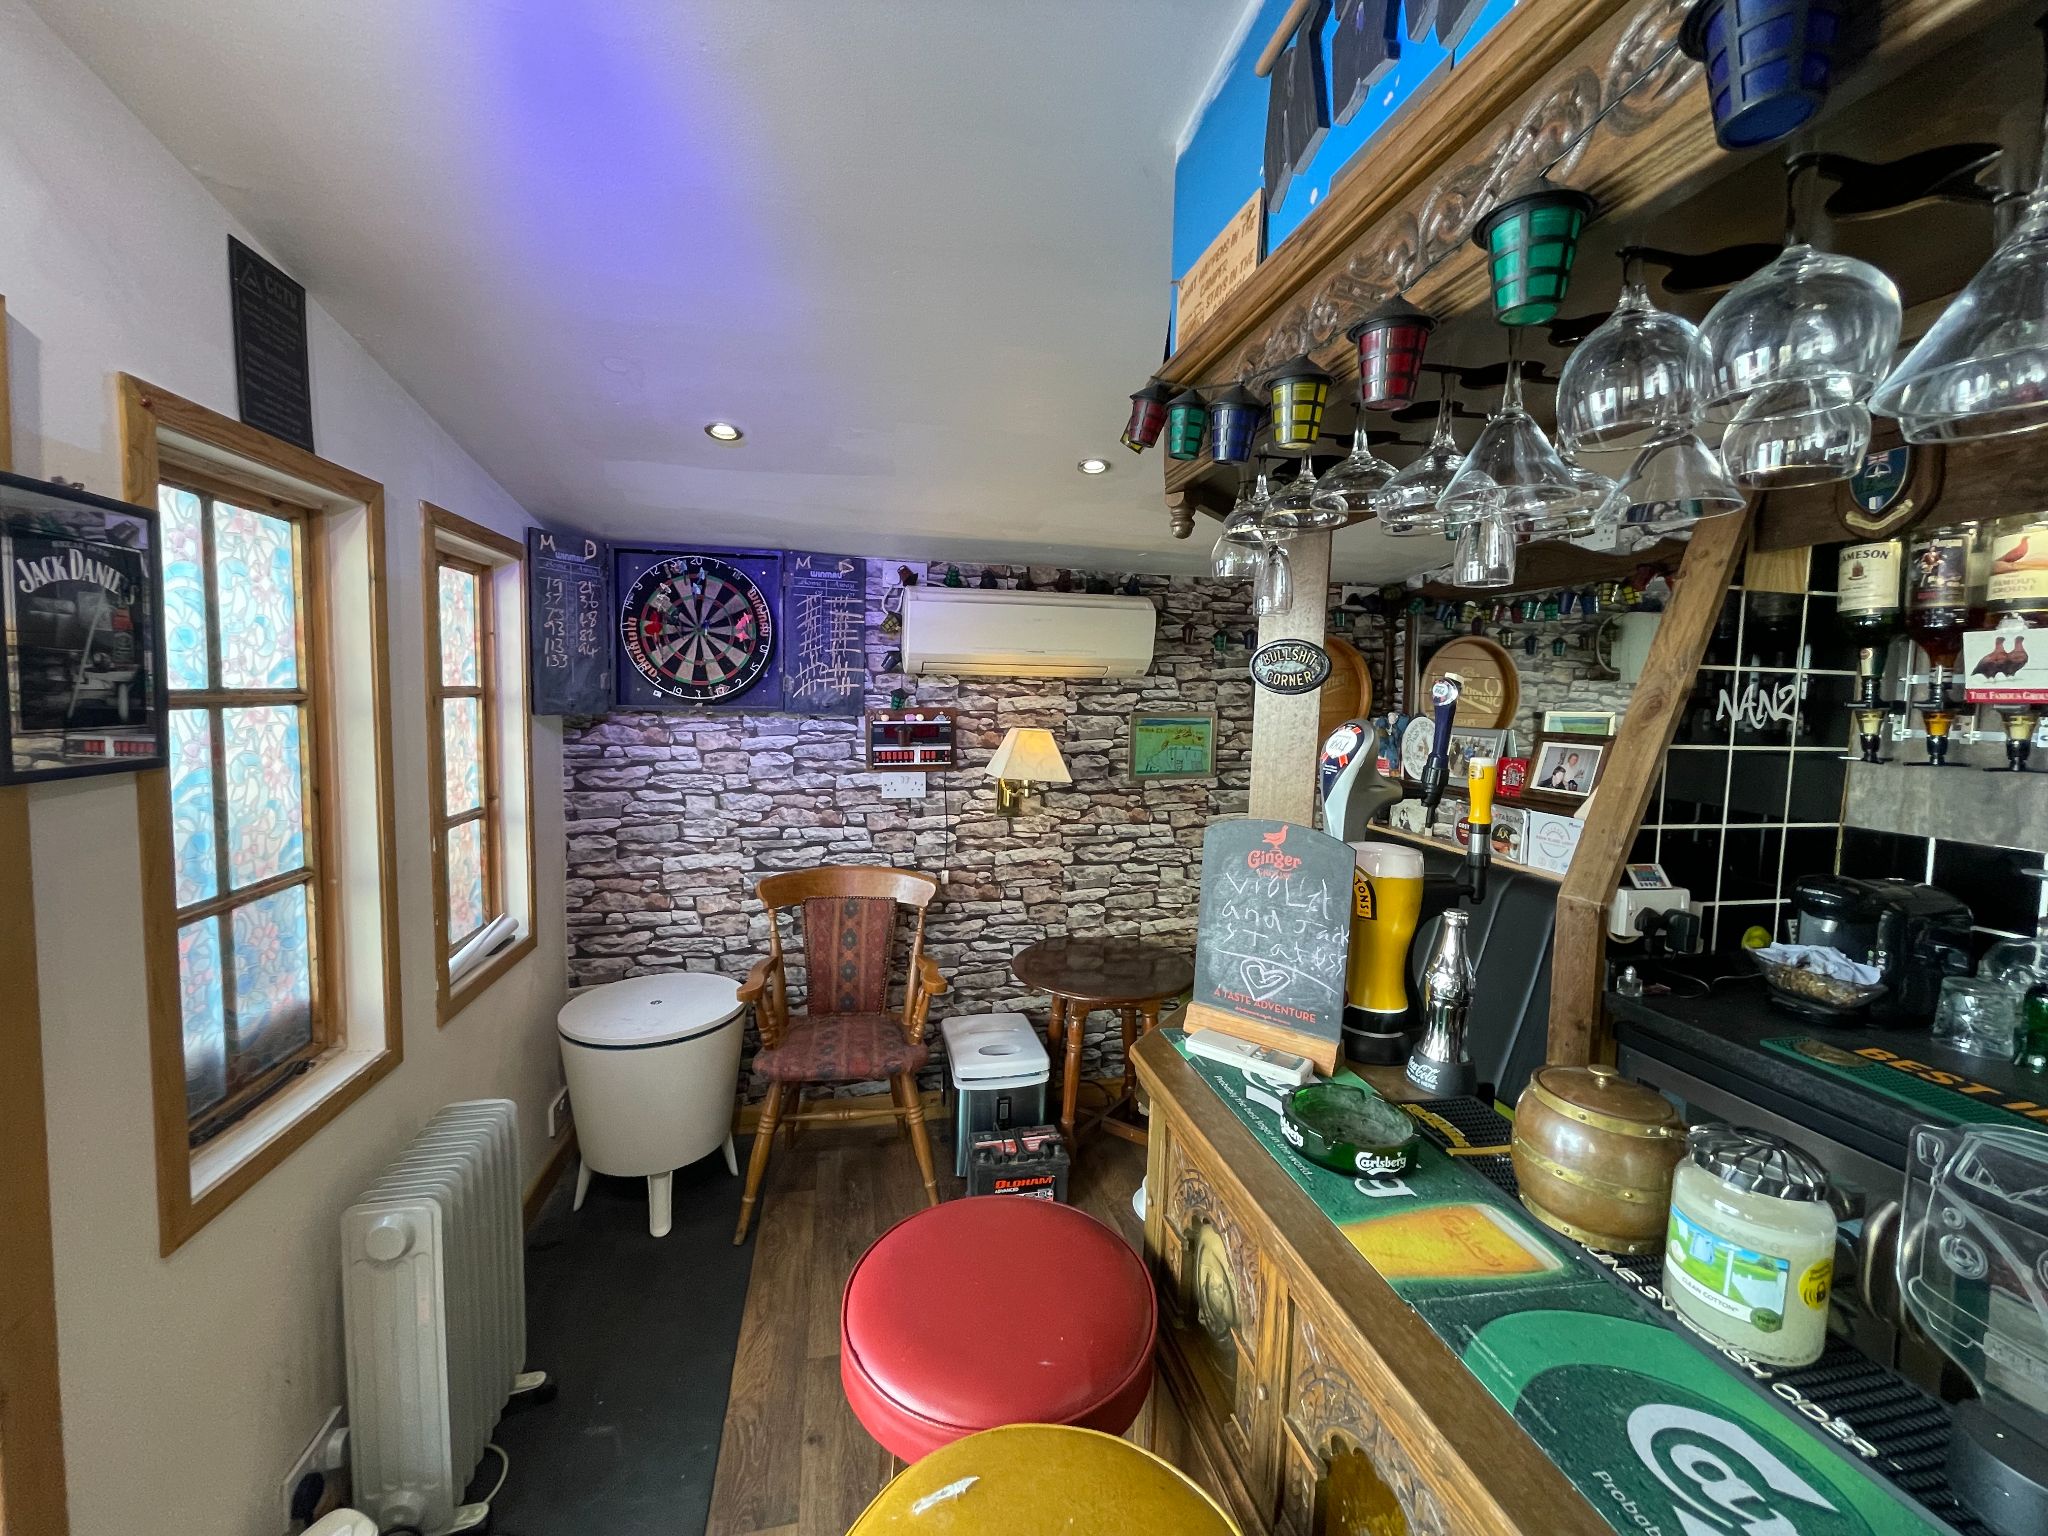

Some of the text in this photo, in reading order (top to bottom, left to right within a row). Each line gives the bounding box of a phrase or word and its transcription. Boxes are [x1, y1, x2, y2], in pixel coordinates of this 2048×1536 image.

[1841, 549, 1890, 561] AMESON
[16, 553, 69, 593] JACK
[1262, 648, 1318, 666] BULLSHIT
[1266, 671, 1313, 687] CORNER
[1458, 821, 1470, 830] COST
[1499, 812, 1524, 824] TASSIMO
[1247, 850, 1302, 871] Ginger
[1213, 988, 1221, 997] A
[1223, 990, 1252, 1005] TASTE
[1253, 1000, 1317, 1024] ADVENTURE
[1854, 1047, 2004, 1095] BEST
[1355, 1151, 1407, 1176] Carlsberg
[995, 1176, 1053, 1189] OLDHAM
